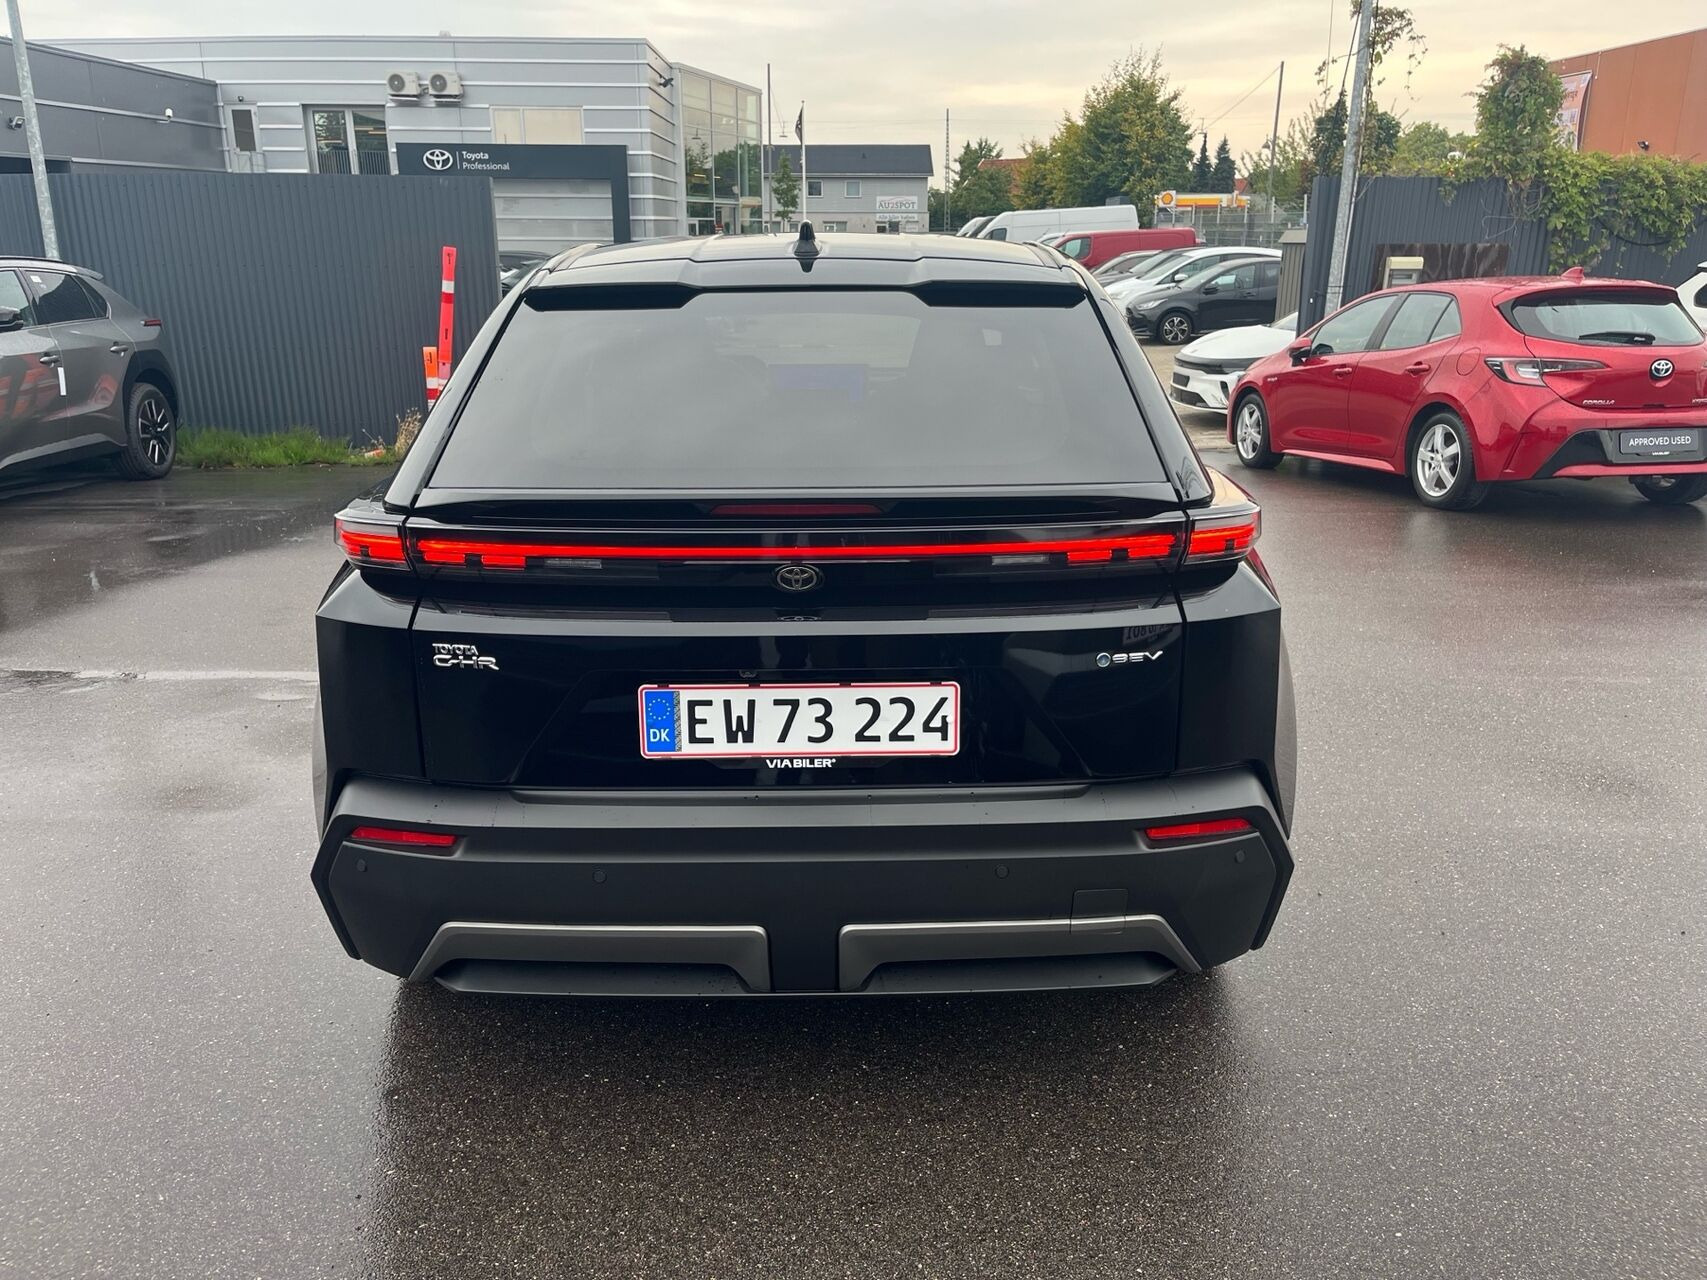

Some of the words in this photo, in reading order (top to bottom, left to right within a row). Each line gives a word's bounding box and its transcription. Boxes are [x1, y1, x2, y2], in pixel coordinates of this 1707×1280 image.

[462, 151, 489, 160] Toyota
[462, 162, 510, 170] Professional
[1629, 436, 1670, 447] APPROVED
[1671, 435, 1692, 445] USED
[432, 643, 479, 655] TOYOTA
[433, 655, 500, 670] C-HR
[687, 698, 756, 744] EW
[772, 697, 834, 743] 73
[854, 696, 949, 742] 224
[650, 728, 671, 743] DK
